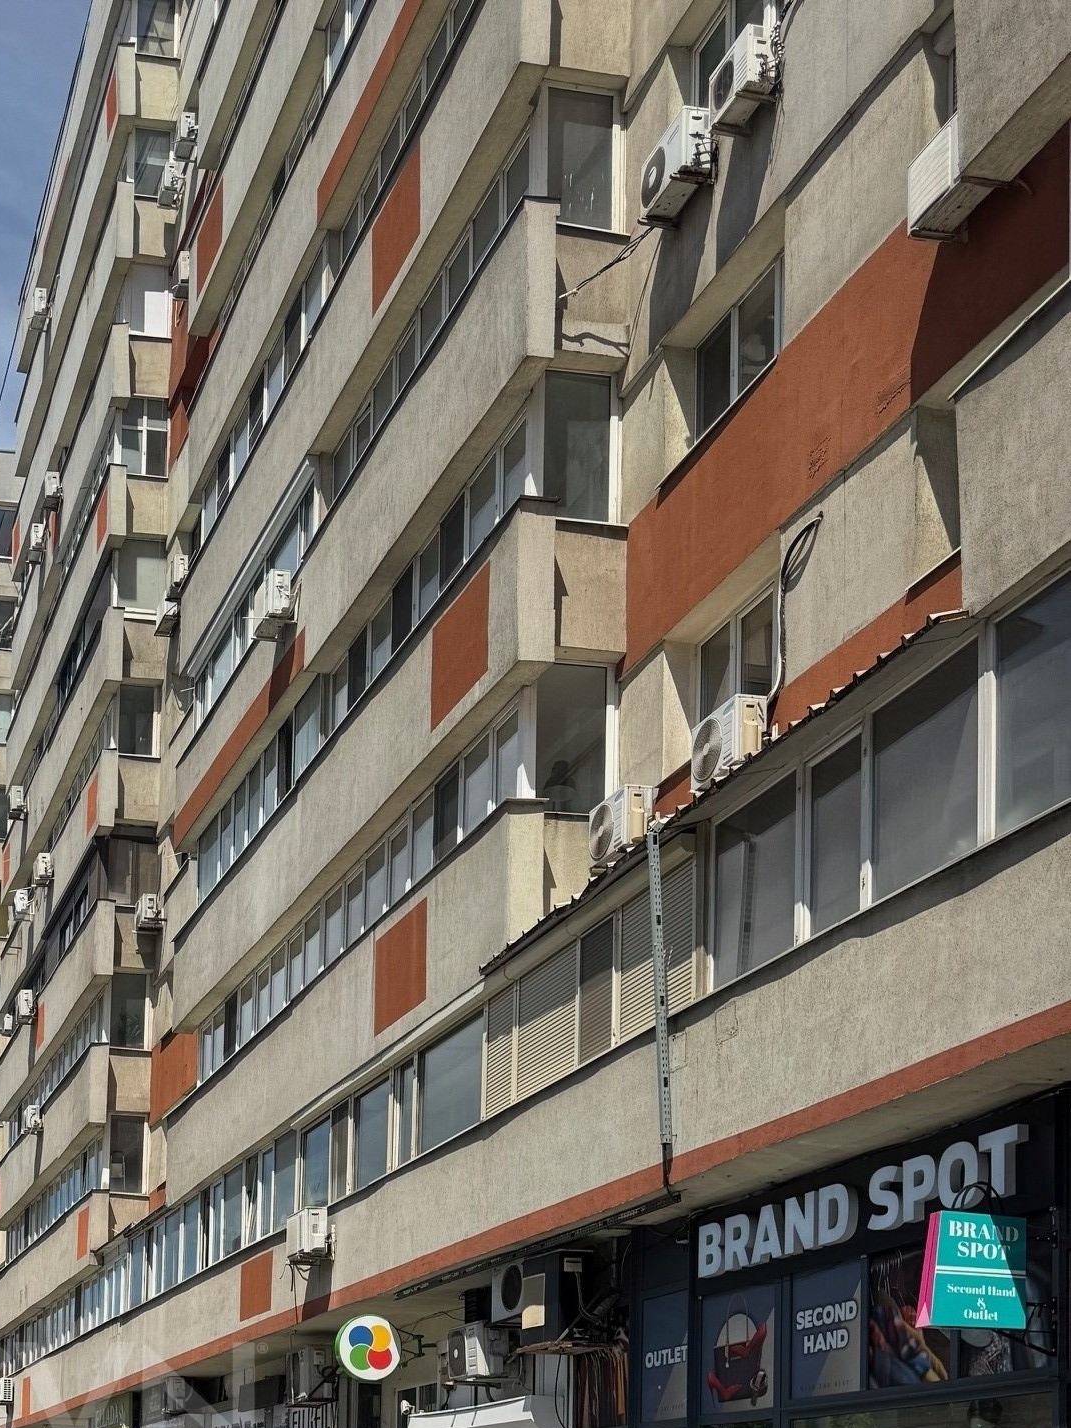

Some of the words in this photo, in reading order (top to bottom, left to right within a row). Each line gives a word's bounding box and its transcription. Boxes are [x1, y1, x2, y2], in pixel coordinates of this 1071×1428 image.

[698, 1183, 857, 1278] BRAND
[868, 1124, 1027, 1230] SPOT
[949, 1219, 1019, 1242] BRAND
[957, 1241, 1010, 1261] SPOT
[947, 1283, 986, 1295] Second
[988, 1285, 1016, 1297] Hand
[963, 1308, 998, 1321] Outlet
[976, 1297, 987, 1310] &
[795, 1300, 858, 1331] SECOND
[803, 1328, 850, 1355] HAND
[645, 1345, 688, 1369] OUTLET
